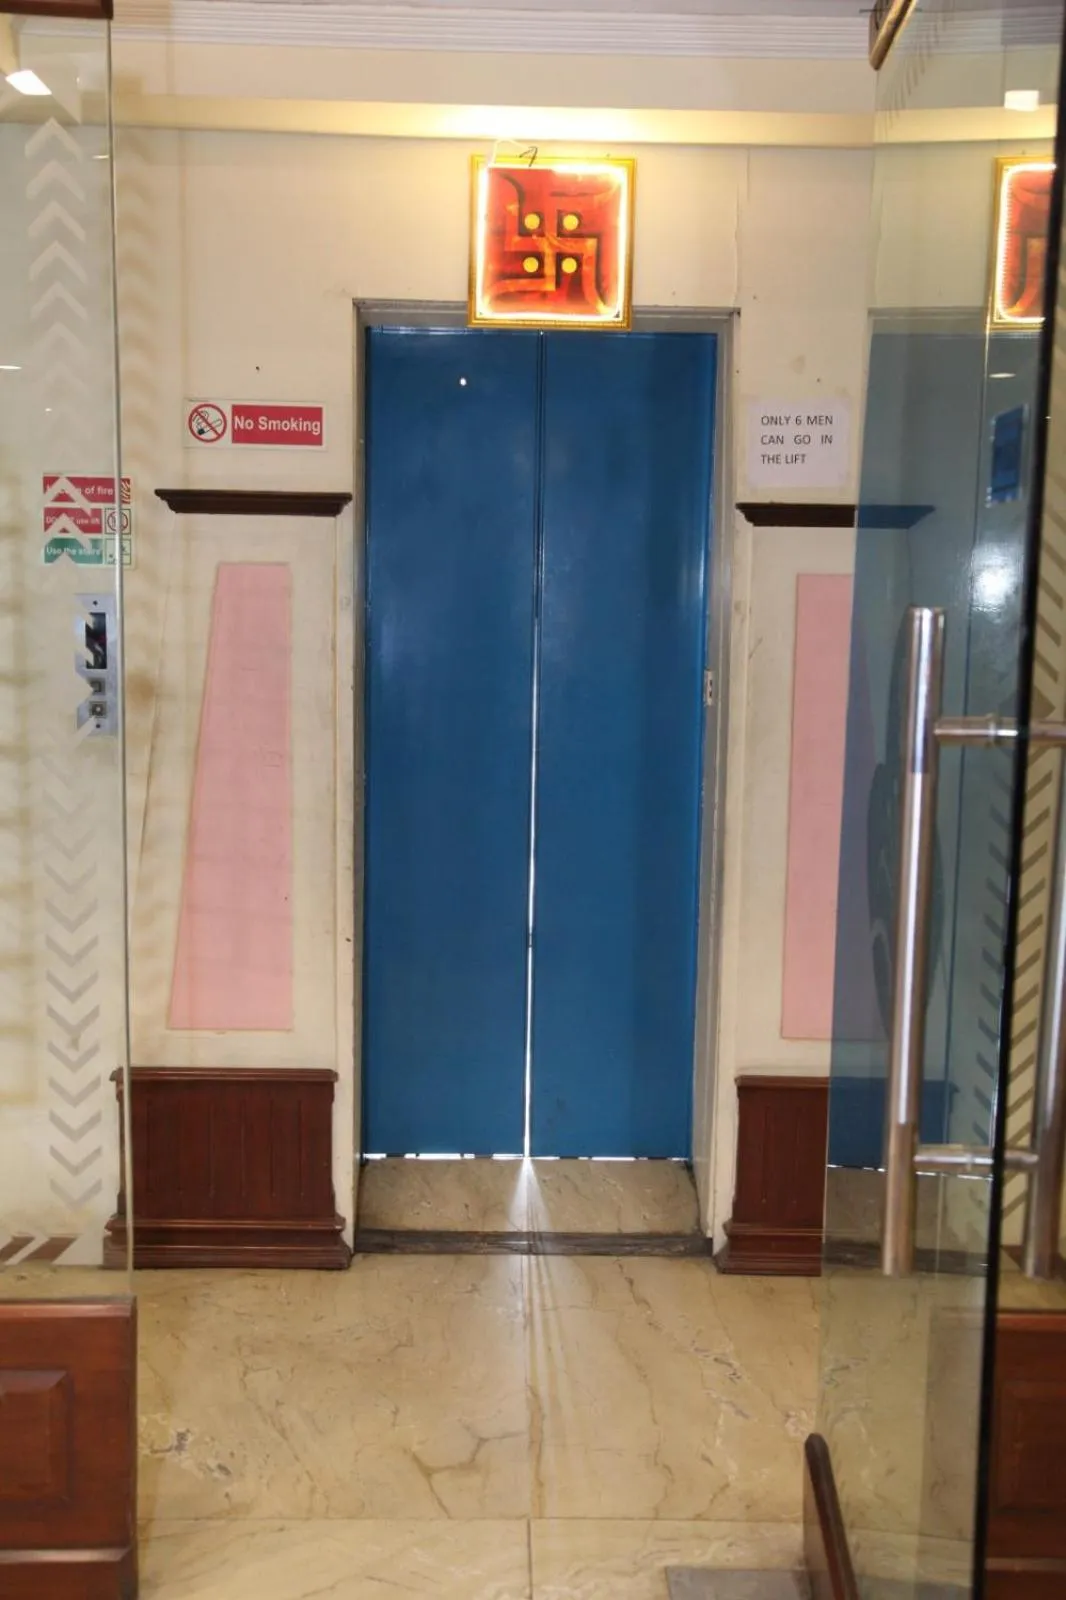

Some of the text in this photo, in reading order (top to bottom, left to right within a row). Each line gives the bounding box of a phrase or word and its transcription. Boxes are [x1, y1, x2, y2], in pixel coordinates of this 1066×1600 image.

[233, 415, 321, 435] No Smoking
[761, 415, 833, 426] ONLY 6 MEN
[760, 434, 833, 445] CAN GO IN
[761, 454, 806, 464] THE LIFT
[85, 486, 95, 495] of
[98, 486, 113, 496] fire
